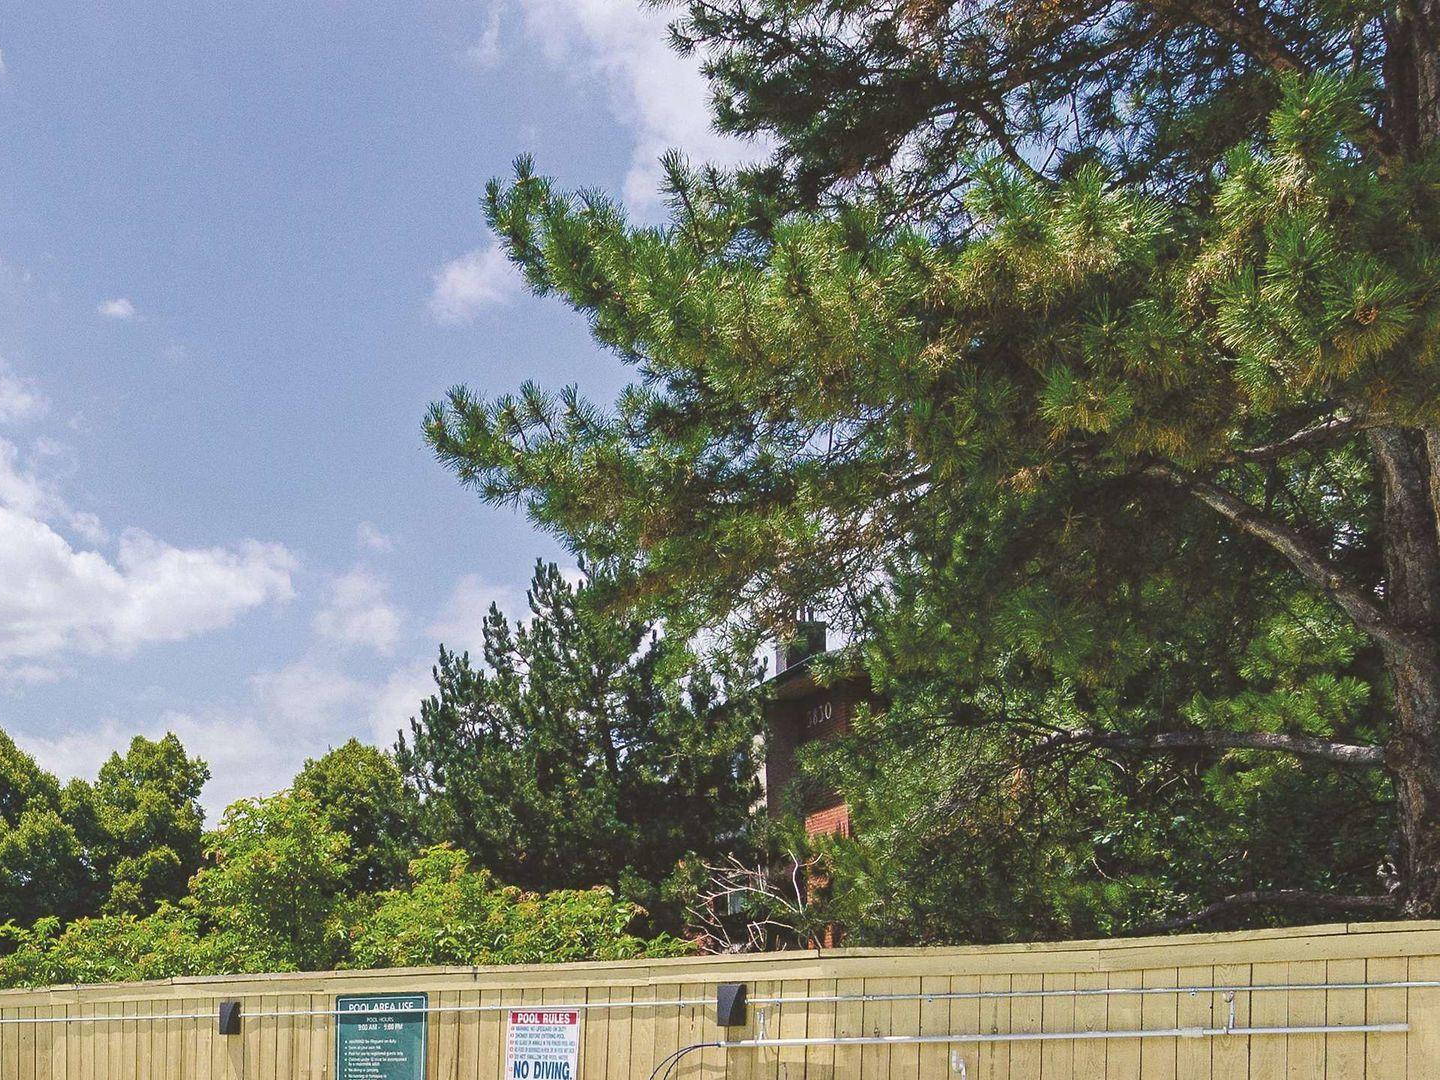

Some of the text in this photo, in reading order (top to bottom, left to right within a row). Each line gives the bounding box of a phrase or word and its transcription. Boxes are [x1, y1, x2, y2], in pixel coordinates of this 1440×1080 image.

[348, 1003, 369, 1012] POOL
[373, 1002, 396, 1011] AREA
[517, 1013, 571, 1024] POOL RULES
[513, 1060, 573, 1080] NO DIVING.
